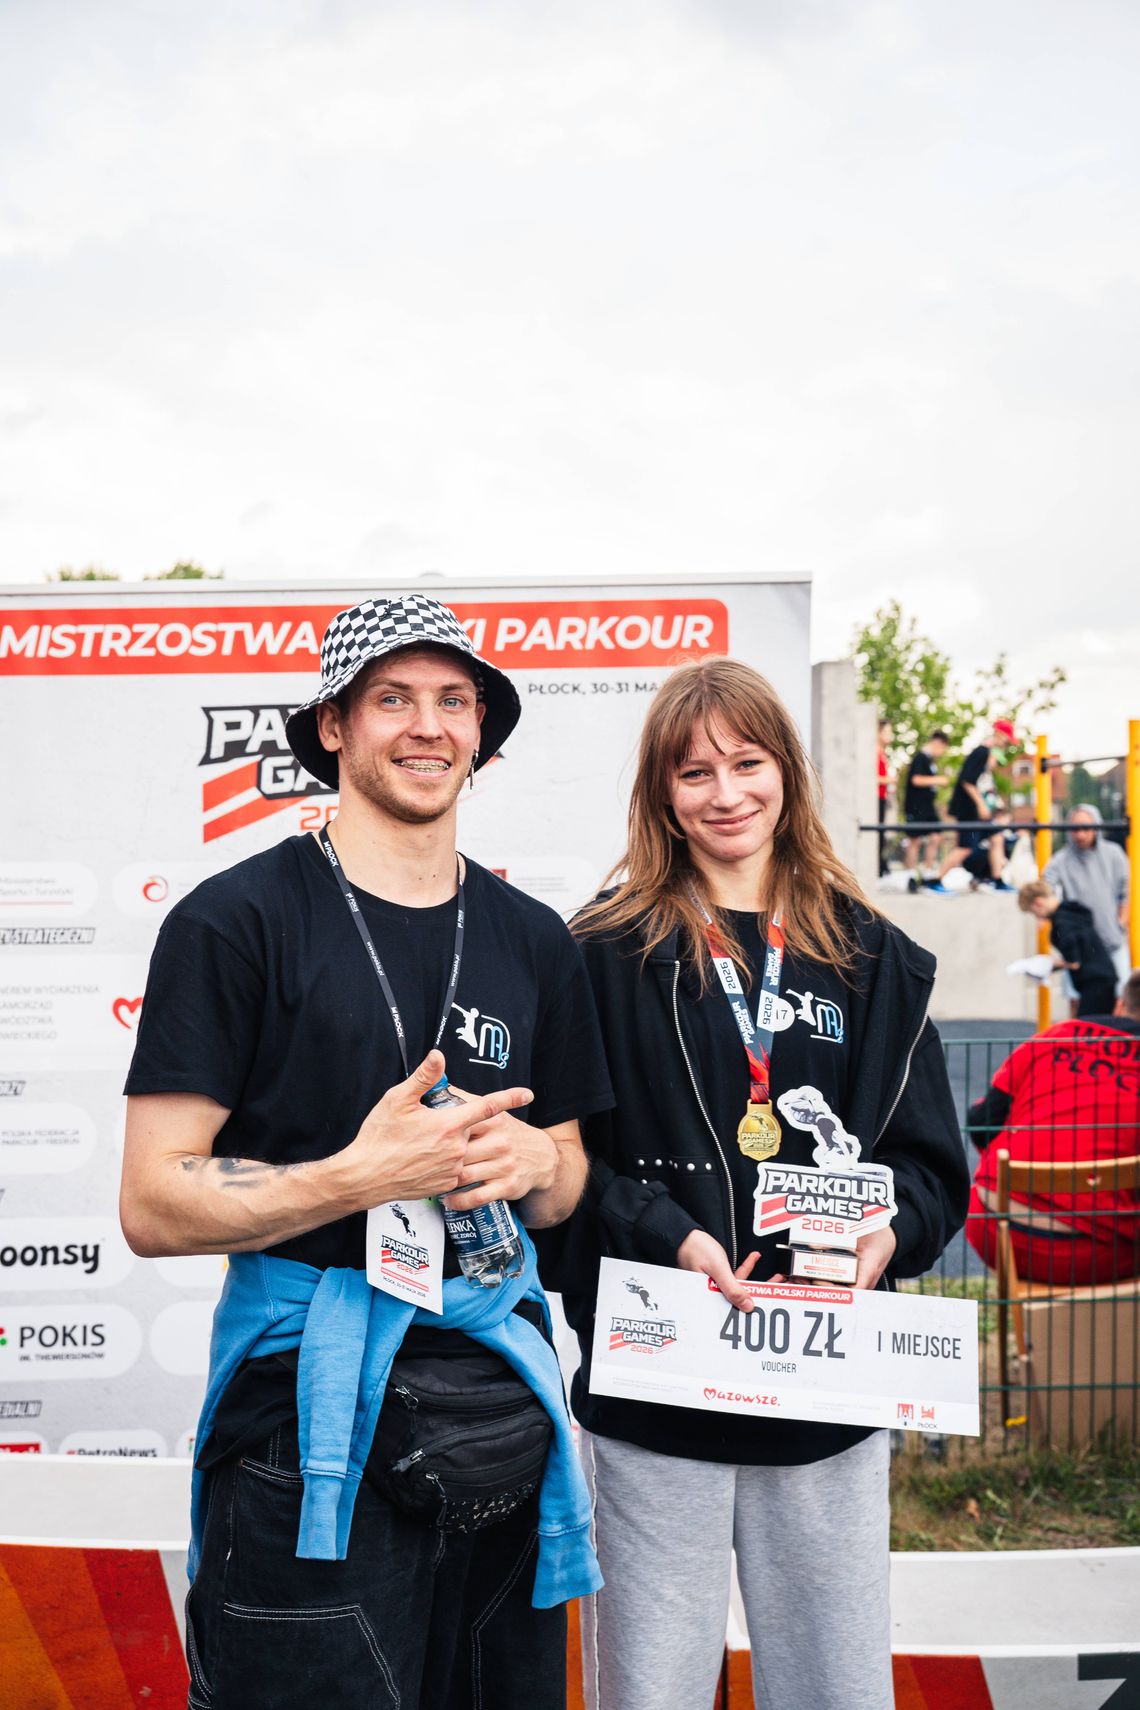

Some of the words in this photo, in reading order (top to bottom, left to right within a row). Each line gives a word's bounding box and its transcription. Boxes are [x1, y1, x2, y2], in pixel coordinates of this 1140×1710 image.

[0, 620, 319, 659] MISTRZOSTWA
[494, 614, 714, 652] PARKOUR
[591, 682, 629, 694] 30-31
[720, 961, 737, 990] 2026
[731, 1001, 754, 1045] PARKOUR
[762, 996, 774, 1025] 2026
[765, 1170, 889, 1206] PARKOUR
[786, 1194, 864, 1220] GAMES
[801, 1217, 845, 1234] 2026
[382, 1236, 430, 1266] PARKOUR
[391, 1250, 420, 1269] GAMES
[773, 1287, 805, 1298] POLSKI
[805, 1290, 851, 1301] PARKOUR
[19, 1323, 106, 1348] POKIS
[611, 1318, 676, 1339] PARKOUR
[622, 1332, 663, 1347] GAMES
[719, 1305, 791, 1355] 400
[802, 1310, 846, 1360] ZŁ
[630, 1344, 654, 1354] 2026
[892, 1332, 962, 1360] MIEJSCE
[761, 1360, 797, 1374] VOUCHER
